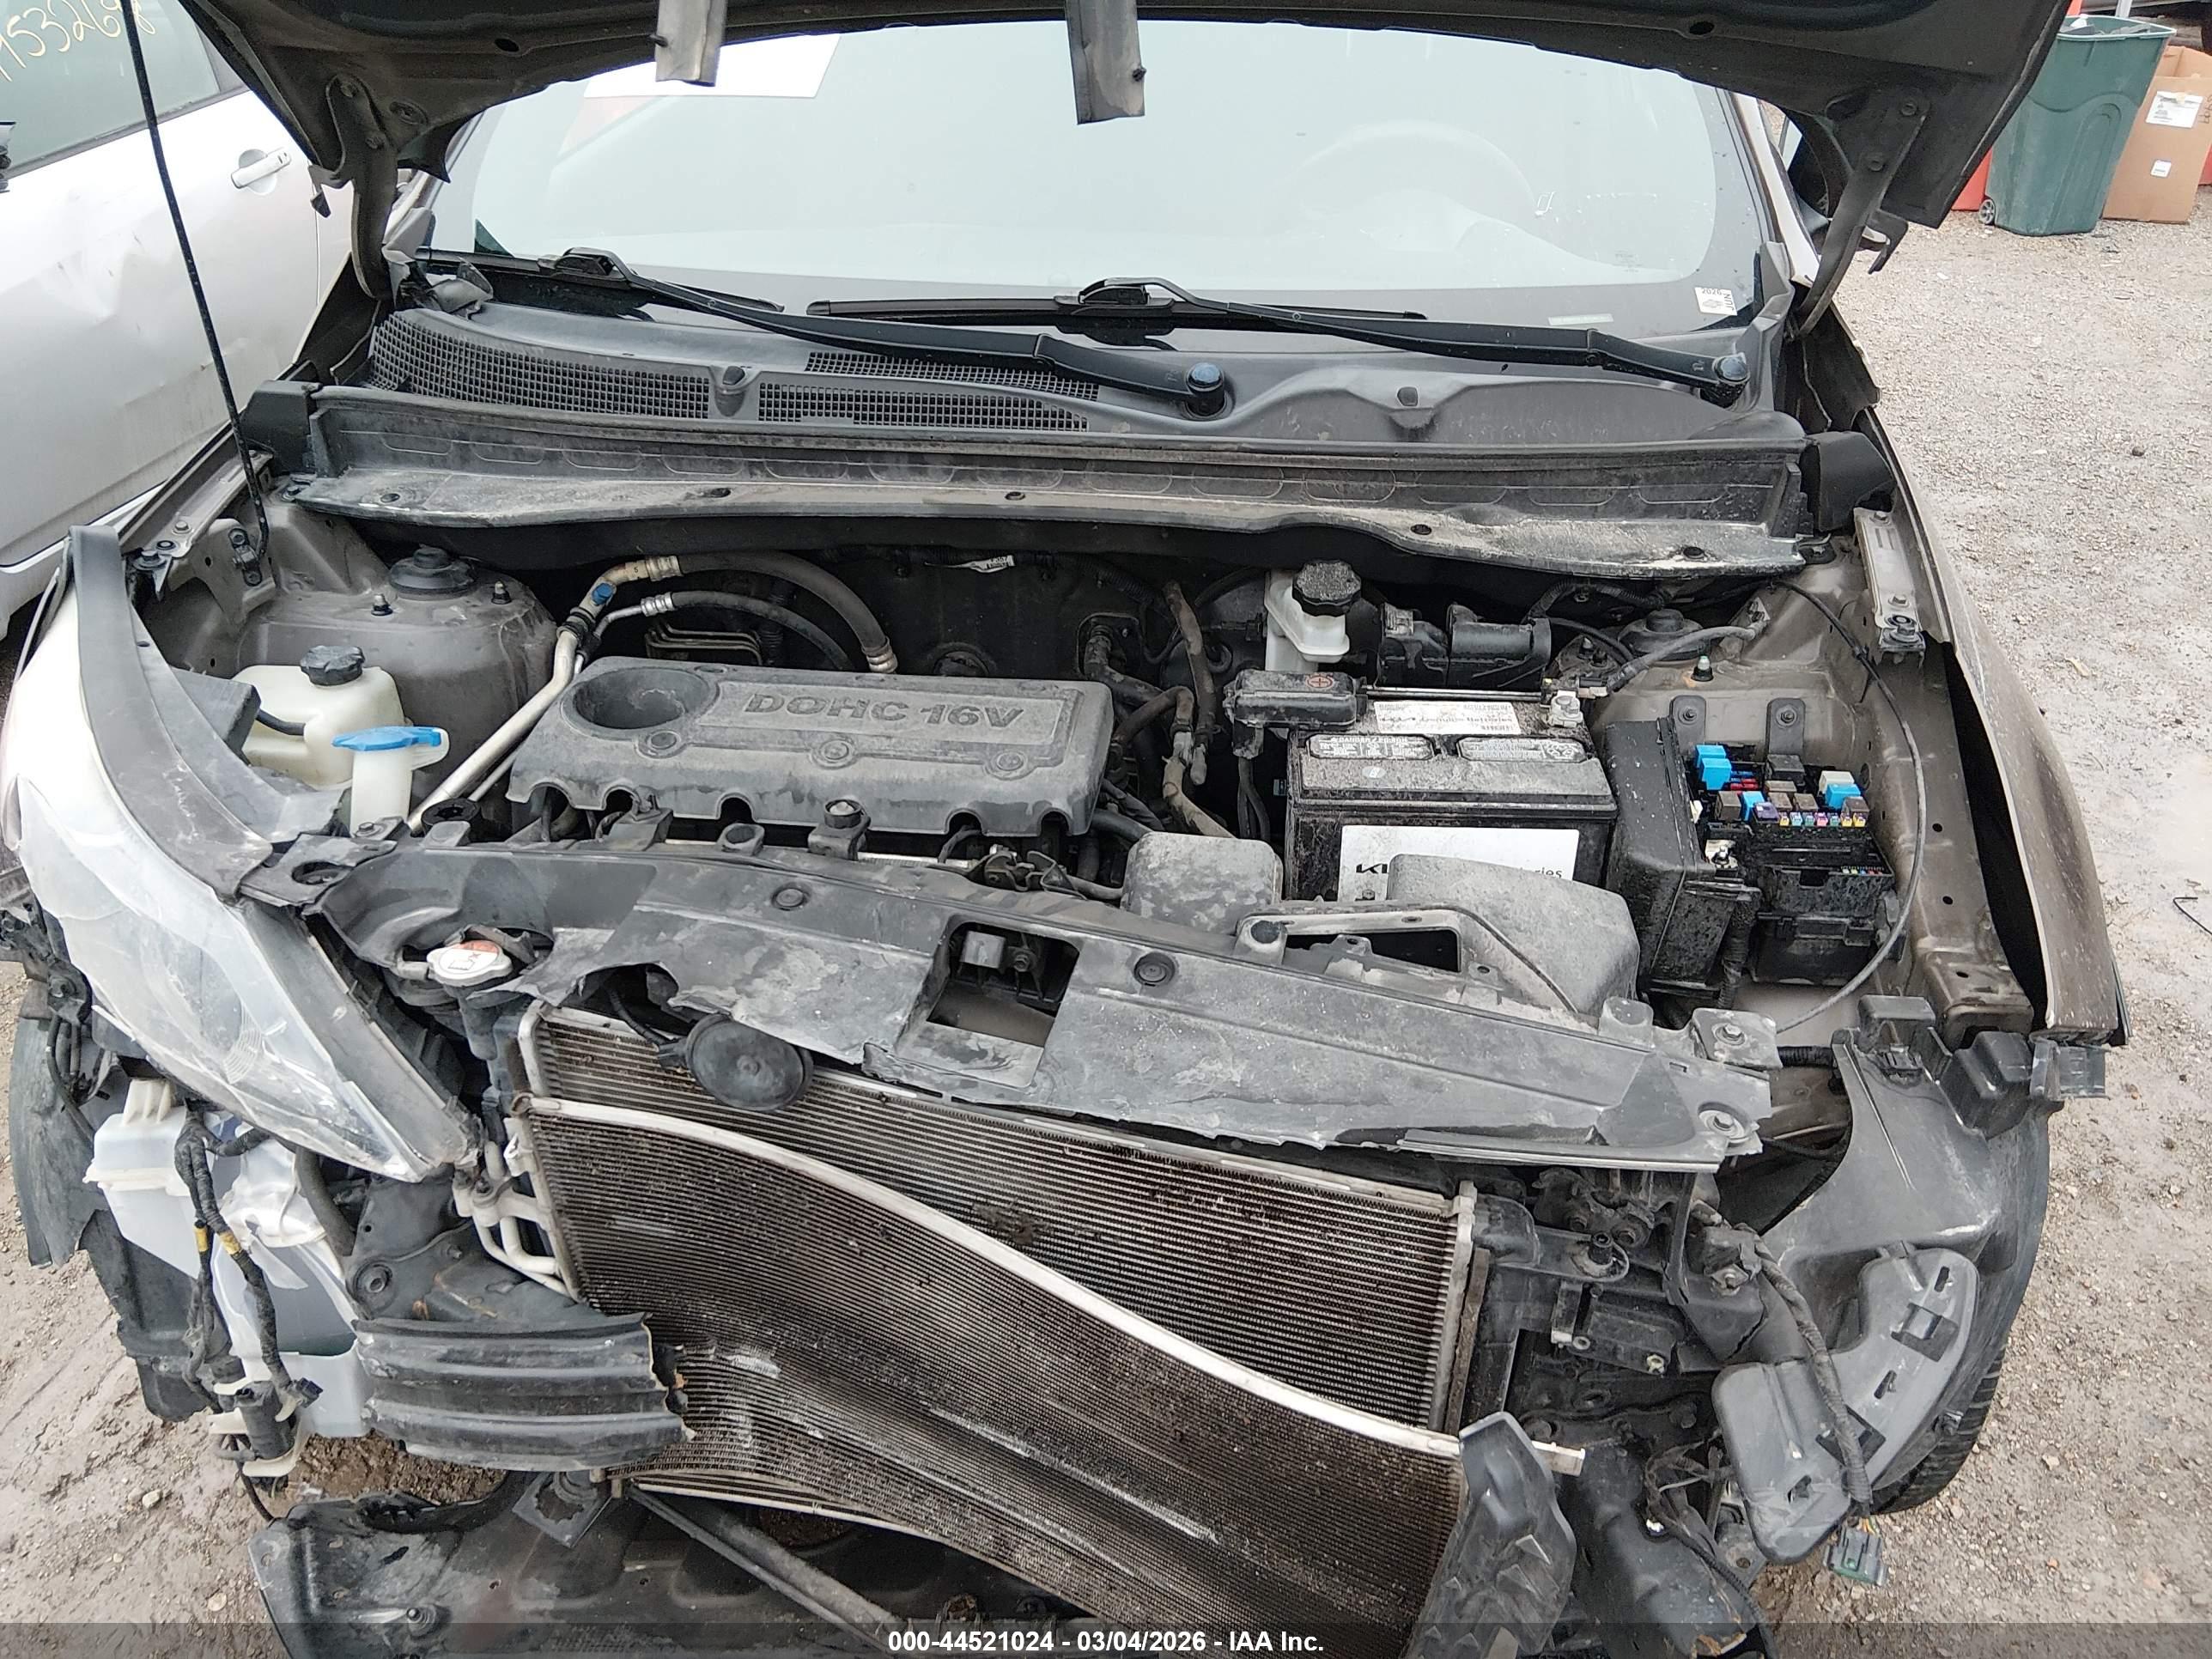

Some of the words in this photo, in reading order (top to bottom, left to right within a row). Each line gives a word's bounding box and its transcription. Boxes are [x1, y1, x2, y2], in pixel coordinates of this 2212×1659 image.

[1722, 293, 1735, 310] JUN
[744, 693, 908, 721] DOHC
[920, 702, 1024, 728] 16V
[1356, 863, 1388, 874] KI
